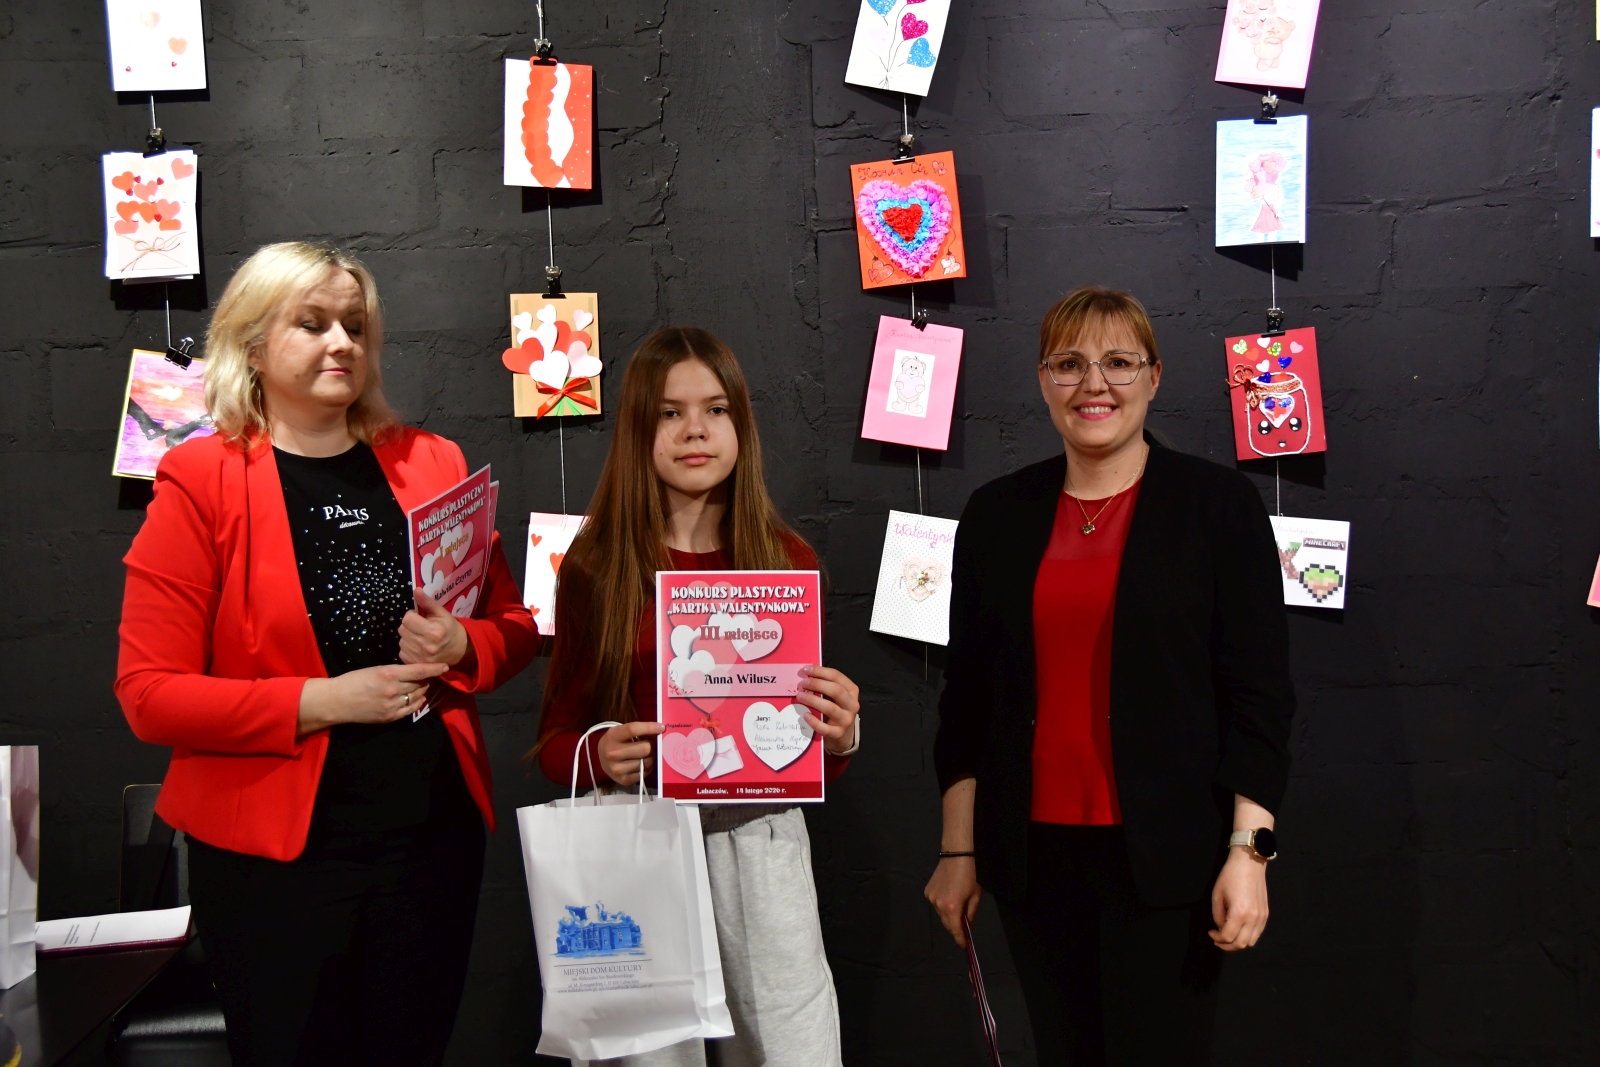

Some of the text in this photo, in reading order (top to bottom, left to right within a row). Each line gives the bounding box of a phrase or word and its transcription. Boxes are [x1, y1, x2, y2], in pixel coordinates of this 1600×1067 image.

[418, 482, 485, 533] KONKURS PLASTYCZNY
[894, 522, 954, 548] Walentynk
[444, 533, 469, 556] miejsce
[1304, 538, 1345, 549] MINECRAFT
[671, 585, 806, 599] KONKURS PLASTYCZNY
[667, 602, 717, 615] „KARTKA
[700, 625, 778, 642] III miejsce
[704, 673, 777, 685] Anna Wilusz
[745, 787, 763, 795] lutego
[563, 964, 643, 976] MIEJSKI DOM KULTURY
